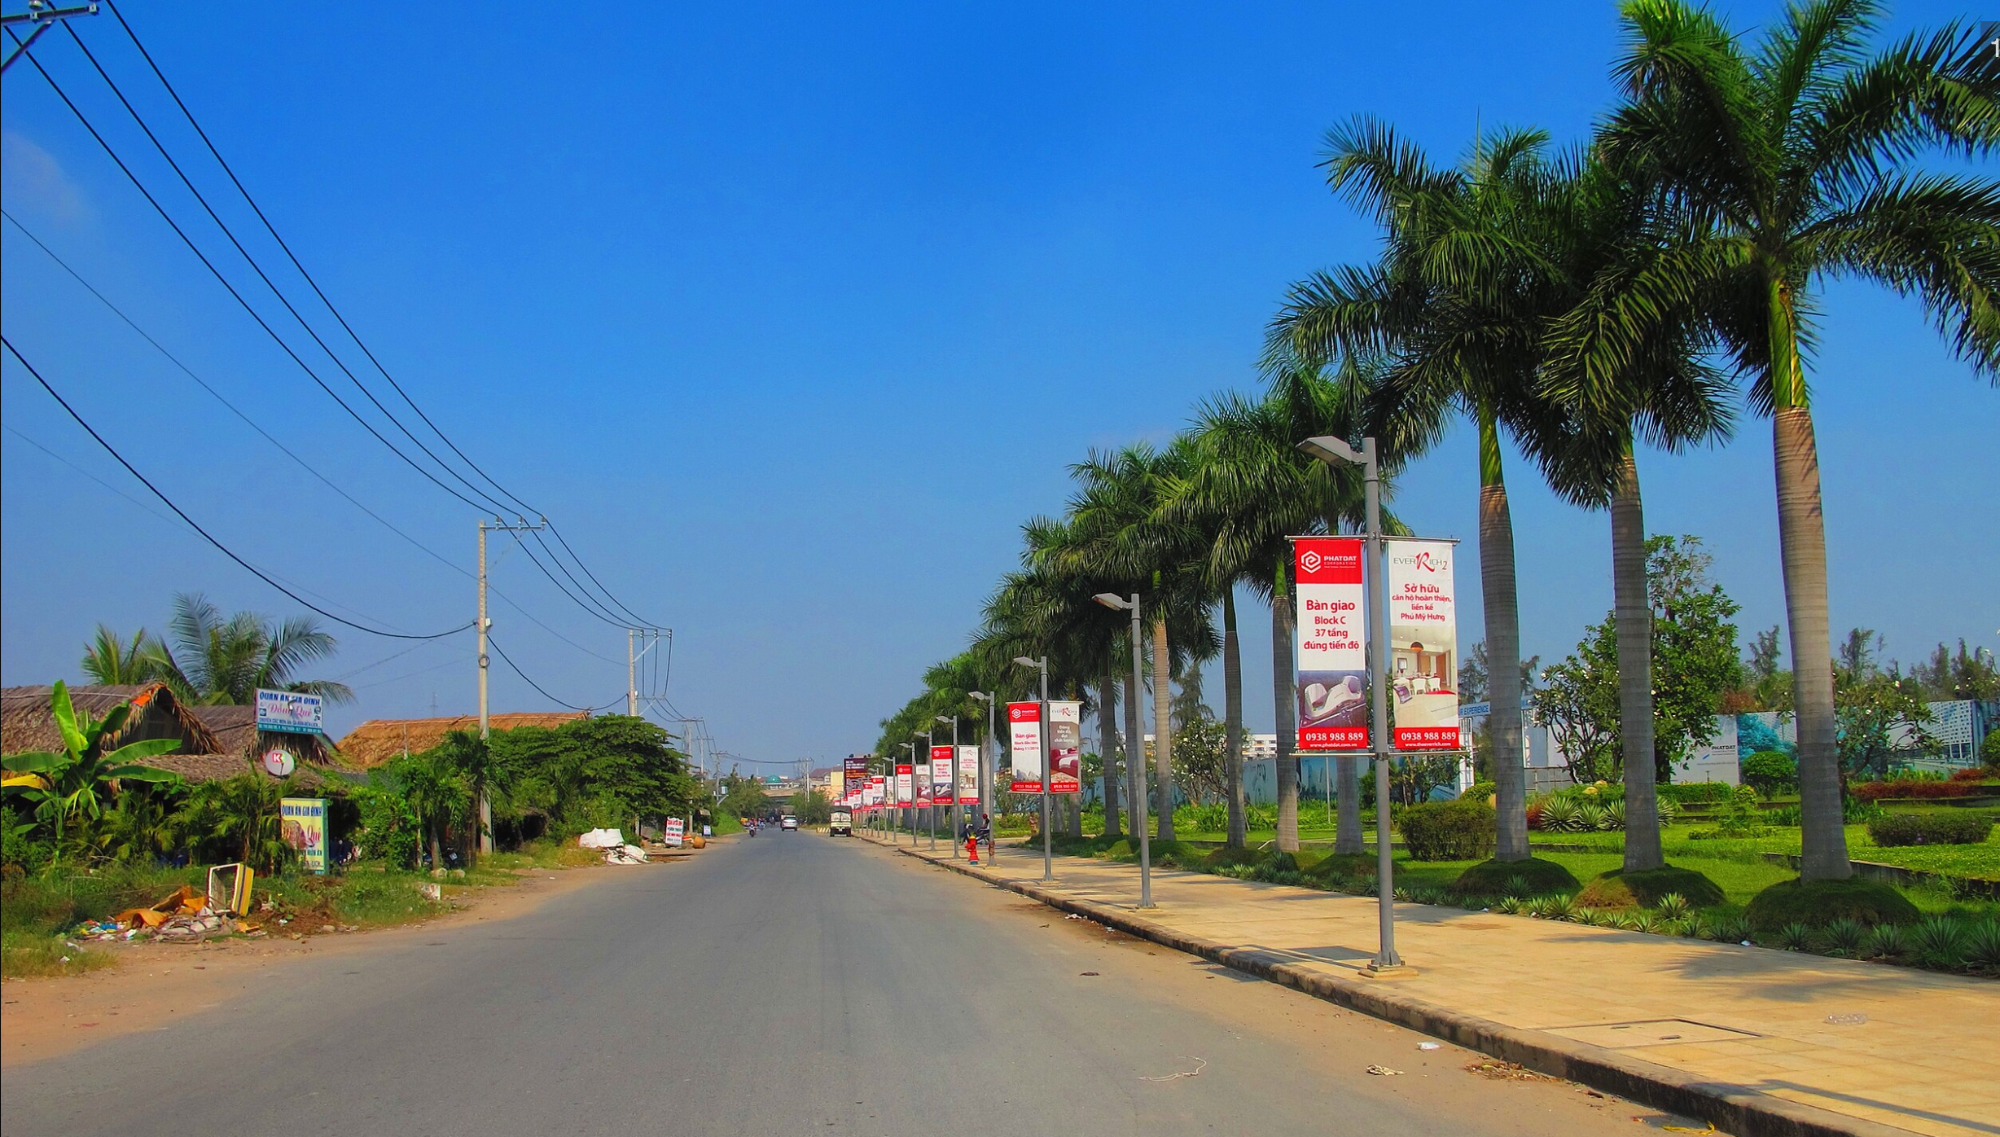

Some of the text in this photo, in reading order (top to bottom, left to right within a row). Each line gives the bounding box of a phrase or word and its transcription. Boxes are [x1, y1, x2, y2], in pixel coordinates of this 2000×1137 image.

[1404, 583, 1440, 593] Sở hữu
[1405, 594, 1414, 602] hộ
[1306, 599, 1356, 613] Bàn giao
[1314, 616, 1346, 625] Block C
[1400, 612, 1414, 620] Phú
[1427, 613, 1446, 622] Hưng
[1315, 629, 1326, 637] 37
[1303, 640, 1328, 652] đúng
[1347, 640, 1360, 652] độ
[1305, 732, 1364, 741] 0938 988 889
[1401, 731, 1457, 741] 0938 988 889
